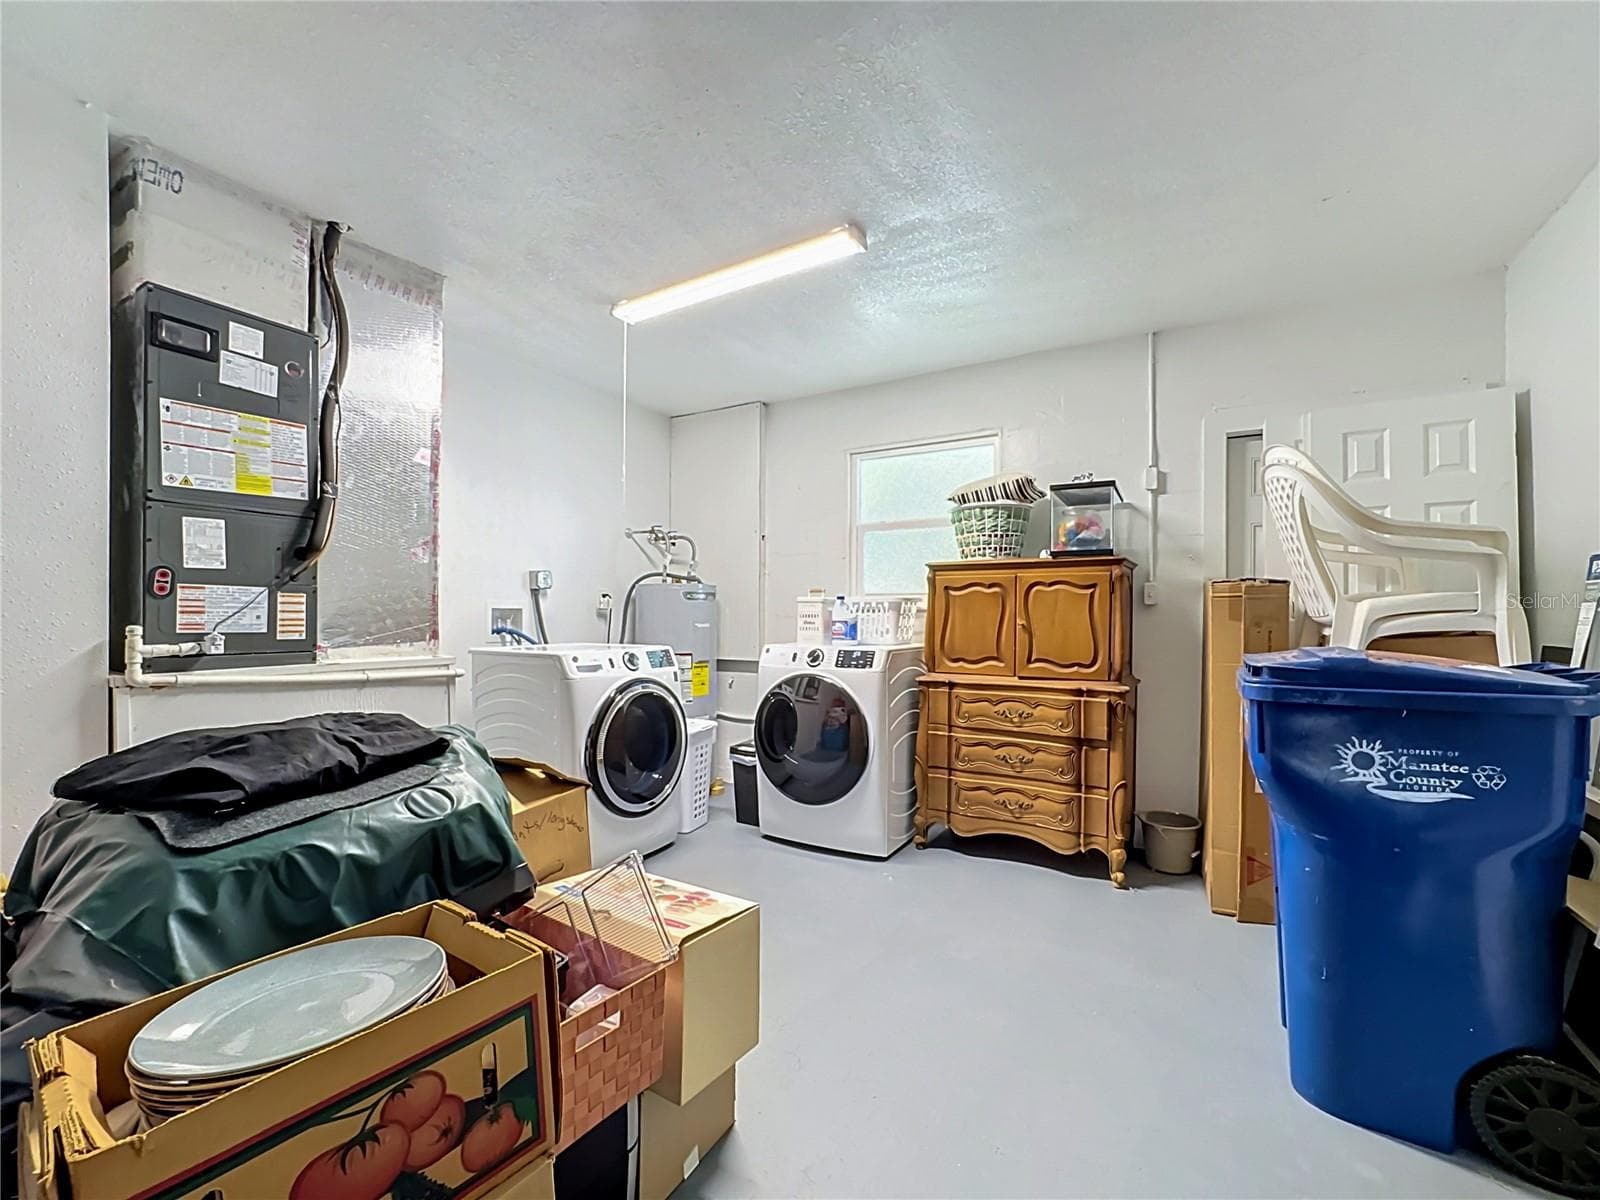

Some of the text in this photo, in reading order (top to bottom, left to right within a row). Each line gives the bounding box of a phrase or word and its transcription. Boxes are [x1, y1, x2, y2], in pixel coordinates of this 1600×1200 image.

[1398, 748, 1443, 756] PROPERTY
[1385, 756, 1470, 773] Manatee
[1389, 769, 1463, 789] County
[1399, 784, 1451, 792] FLORIDA
